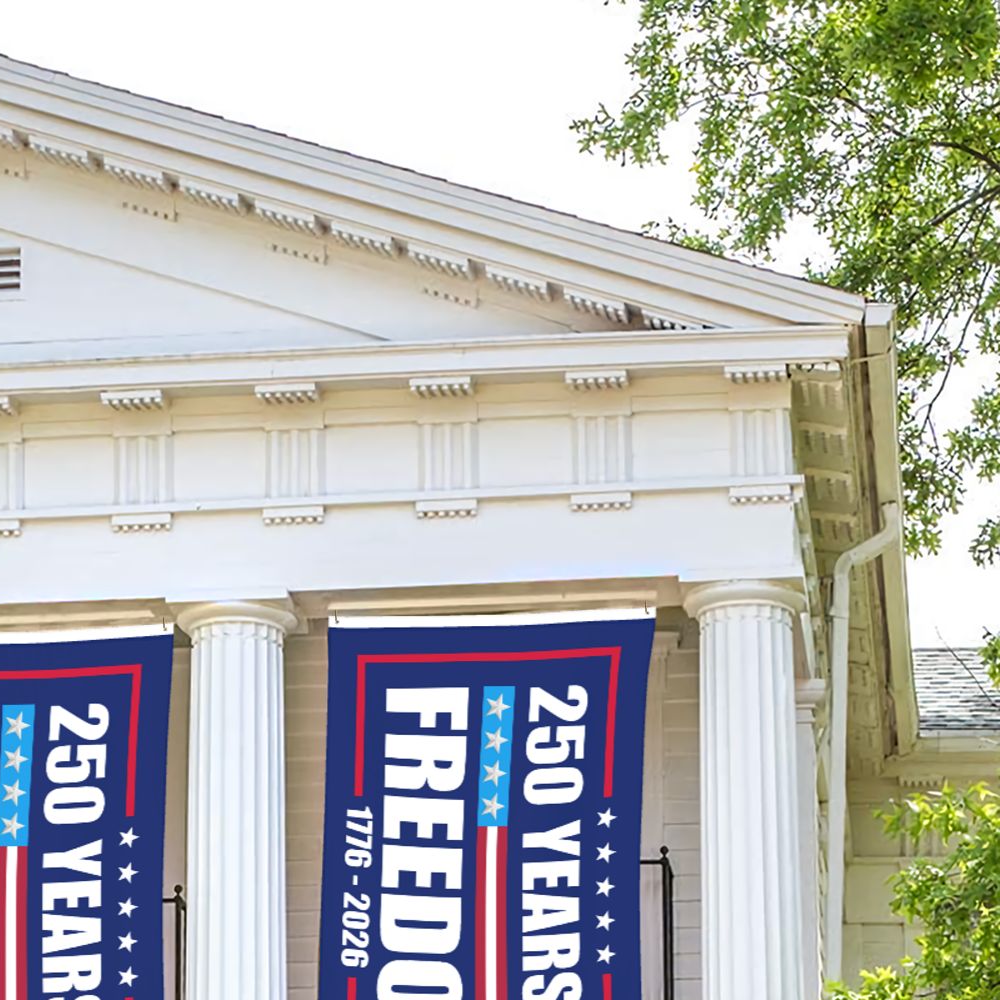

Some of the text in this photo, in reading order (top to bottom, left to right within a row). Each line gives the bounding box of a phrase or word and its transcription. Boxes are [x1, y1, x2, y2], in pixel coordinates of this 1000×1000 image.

[43, 703, 110, 826] 250
[523, 684, 589, 806] 250
[344, 806, 374, 868] 1776
[340, 891, 371, 968] 2026
